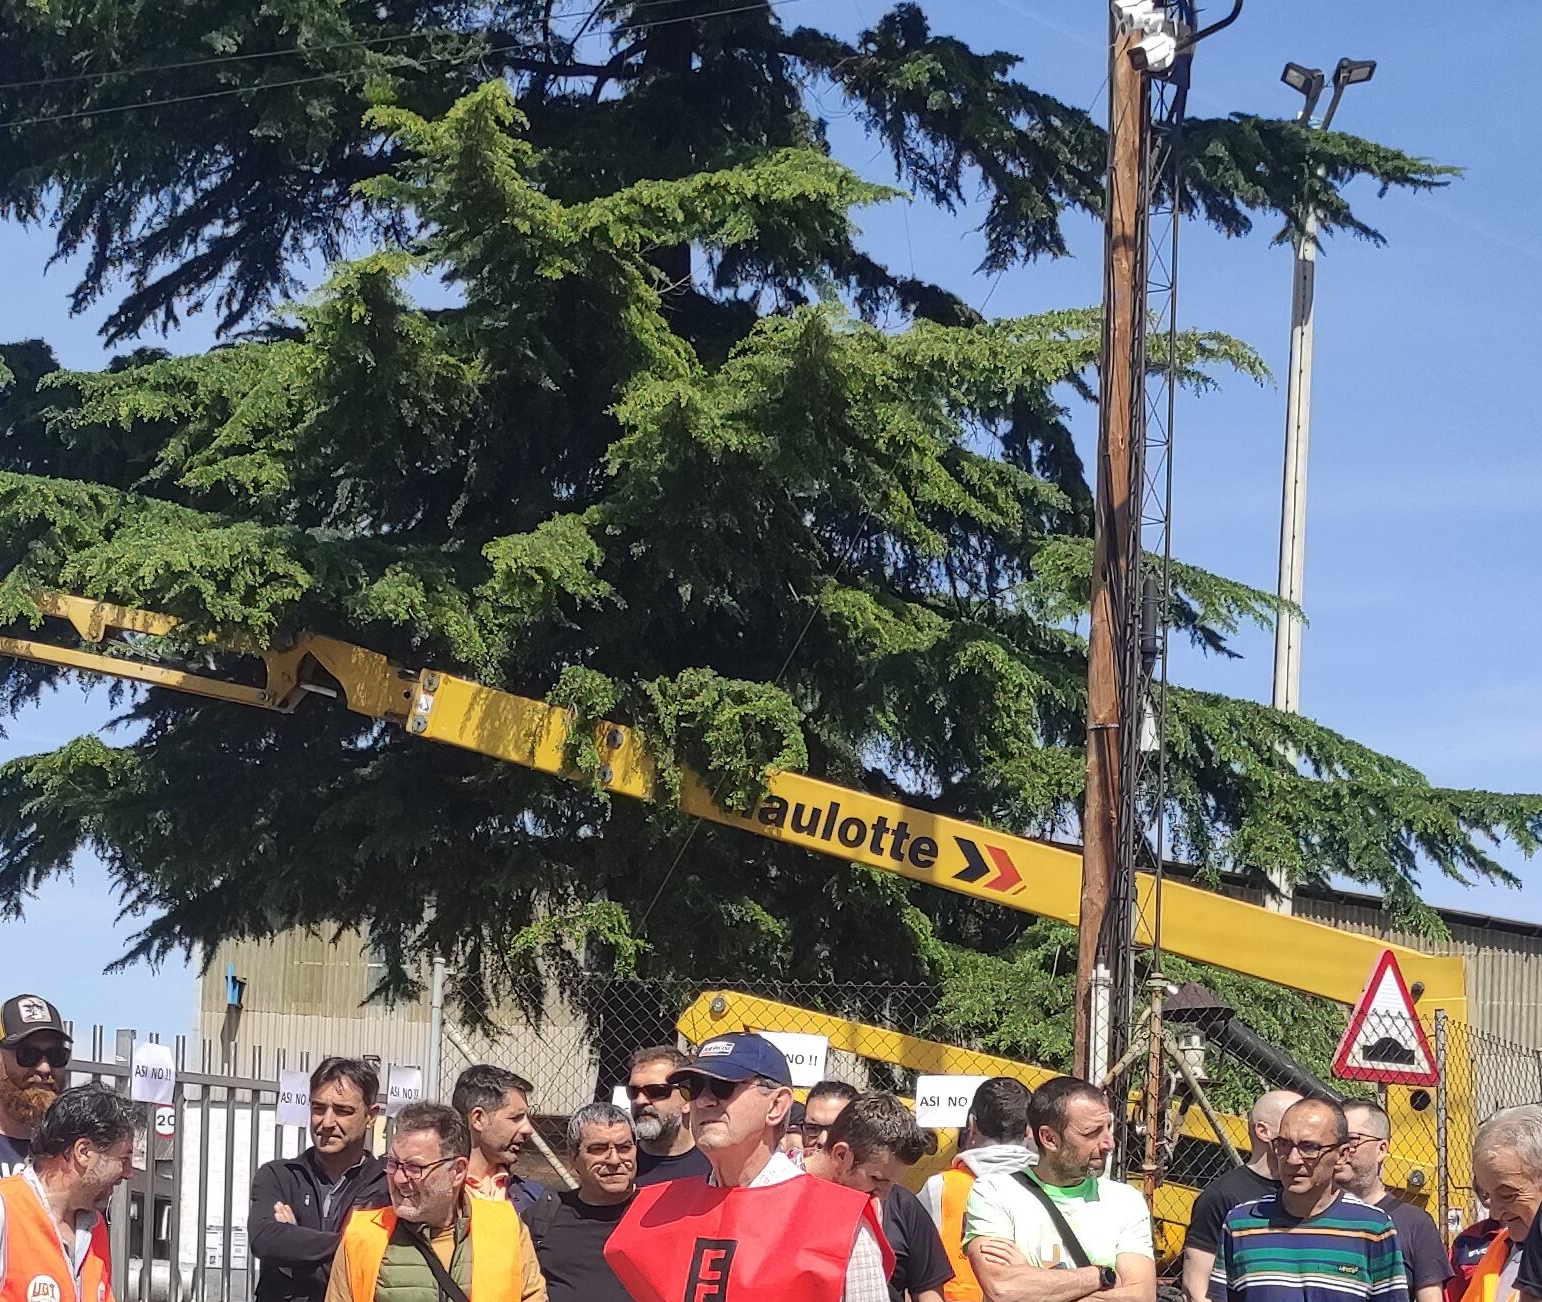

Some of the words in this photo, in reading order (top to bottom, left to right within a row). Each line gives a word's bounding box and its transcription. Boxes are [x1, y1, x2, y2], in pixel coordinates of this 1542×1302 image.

[740, 795, 939, 868] aulotte
[785, 1053, 805, 1065] NO
[151, 1067, 164, 1080] NO
[166, 1068, 171, 1081] !!
[402, 1088, 413, 1099] NO
[295, 1094, 307, 1106] NO
[920, 1096, 939, 1107] ASI
[948, 1096, 968, 1107] NO
[157, 1115, 176, 1126] 20
